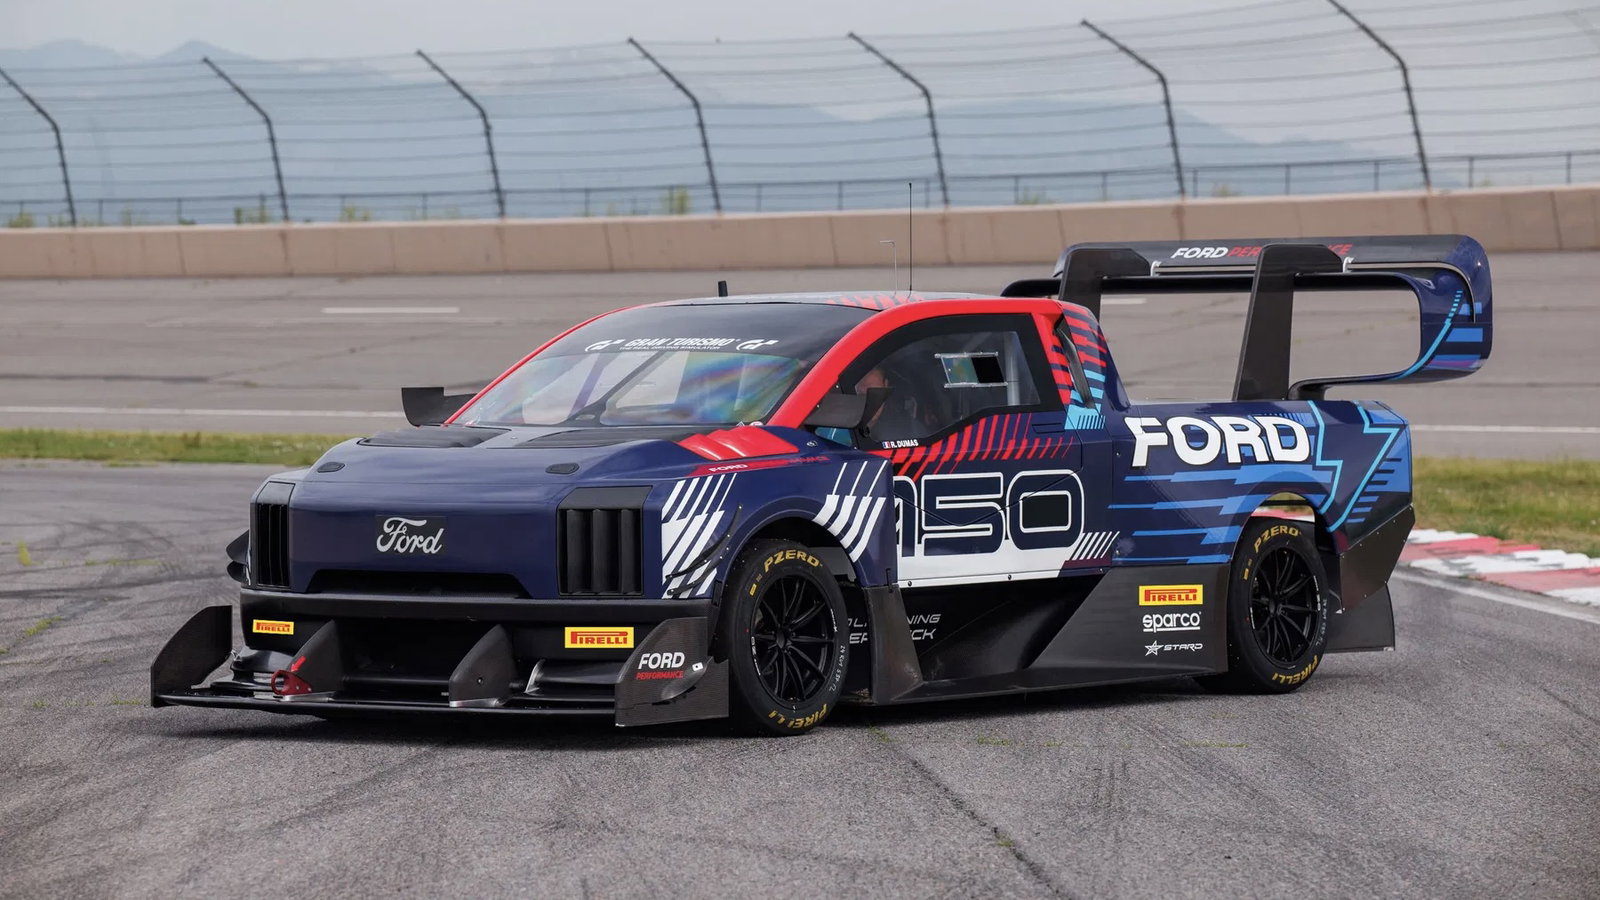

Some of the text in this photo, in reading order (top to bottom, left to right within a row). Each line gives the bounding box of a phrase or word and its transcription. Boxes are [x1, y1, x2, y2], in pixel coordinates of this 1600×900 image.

[1171, 246, 1229, 259] FORD
[624, 338, 735, 347] GRAN TURISMO
[897, 439, 919, 448] DUMAS
[1123, 416, 1310, 467] FORD
[708, 463, 748, 473] FORD
[376, 516, 444, 554] Ford
[1144, 588, 1198, 602] PIRELLI
[256, 622, 291, 633] PIRELLI
[1142, 612, 1201, 633] sparco
[570, 631, 629, 645] PIRELLI
[1163, 643, 1203, 652] STARD
[638, 652, 686, 669] FORD
[635, 670, 684, 680] PERFORMANCE
